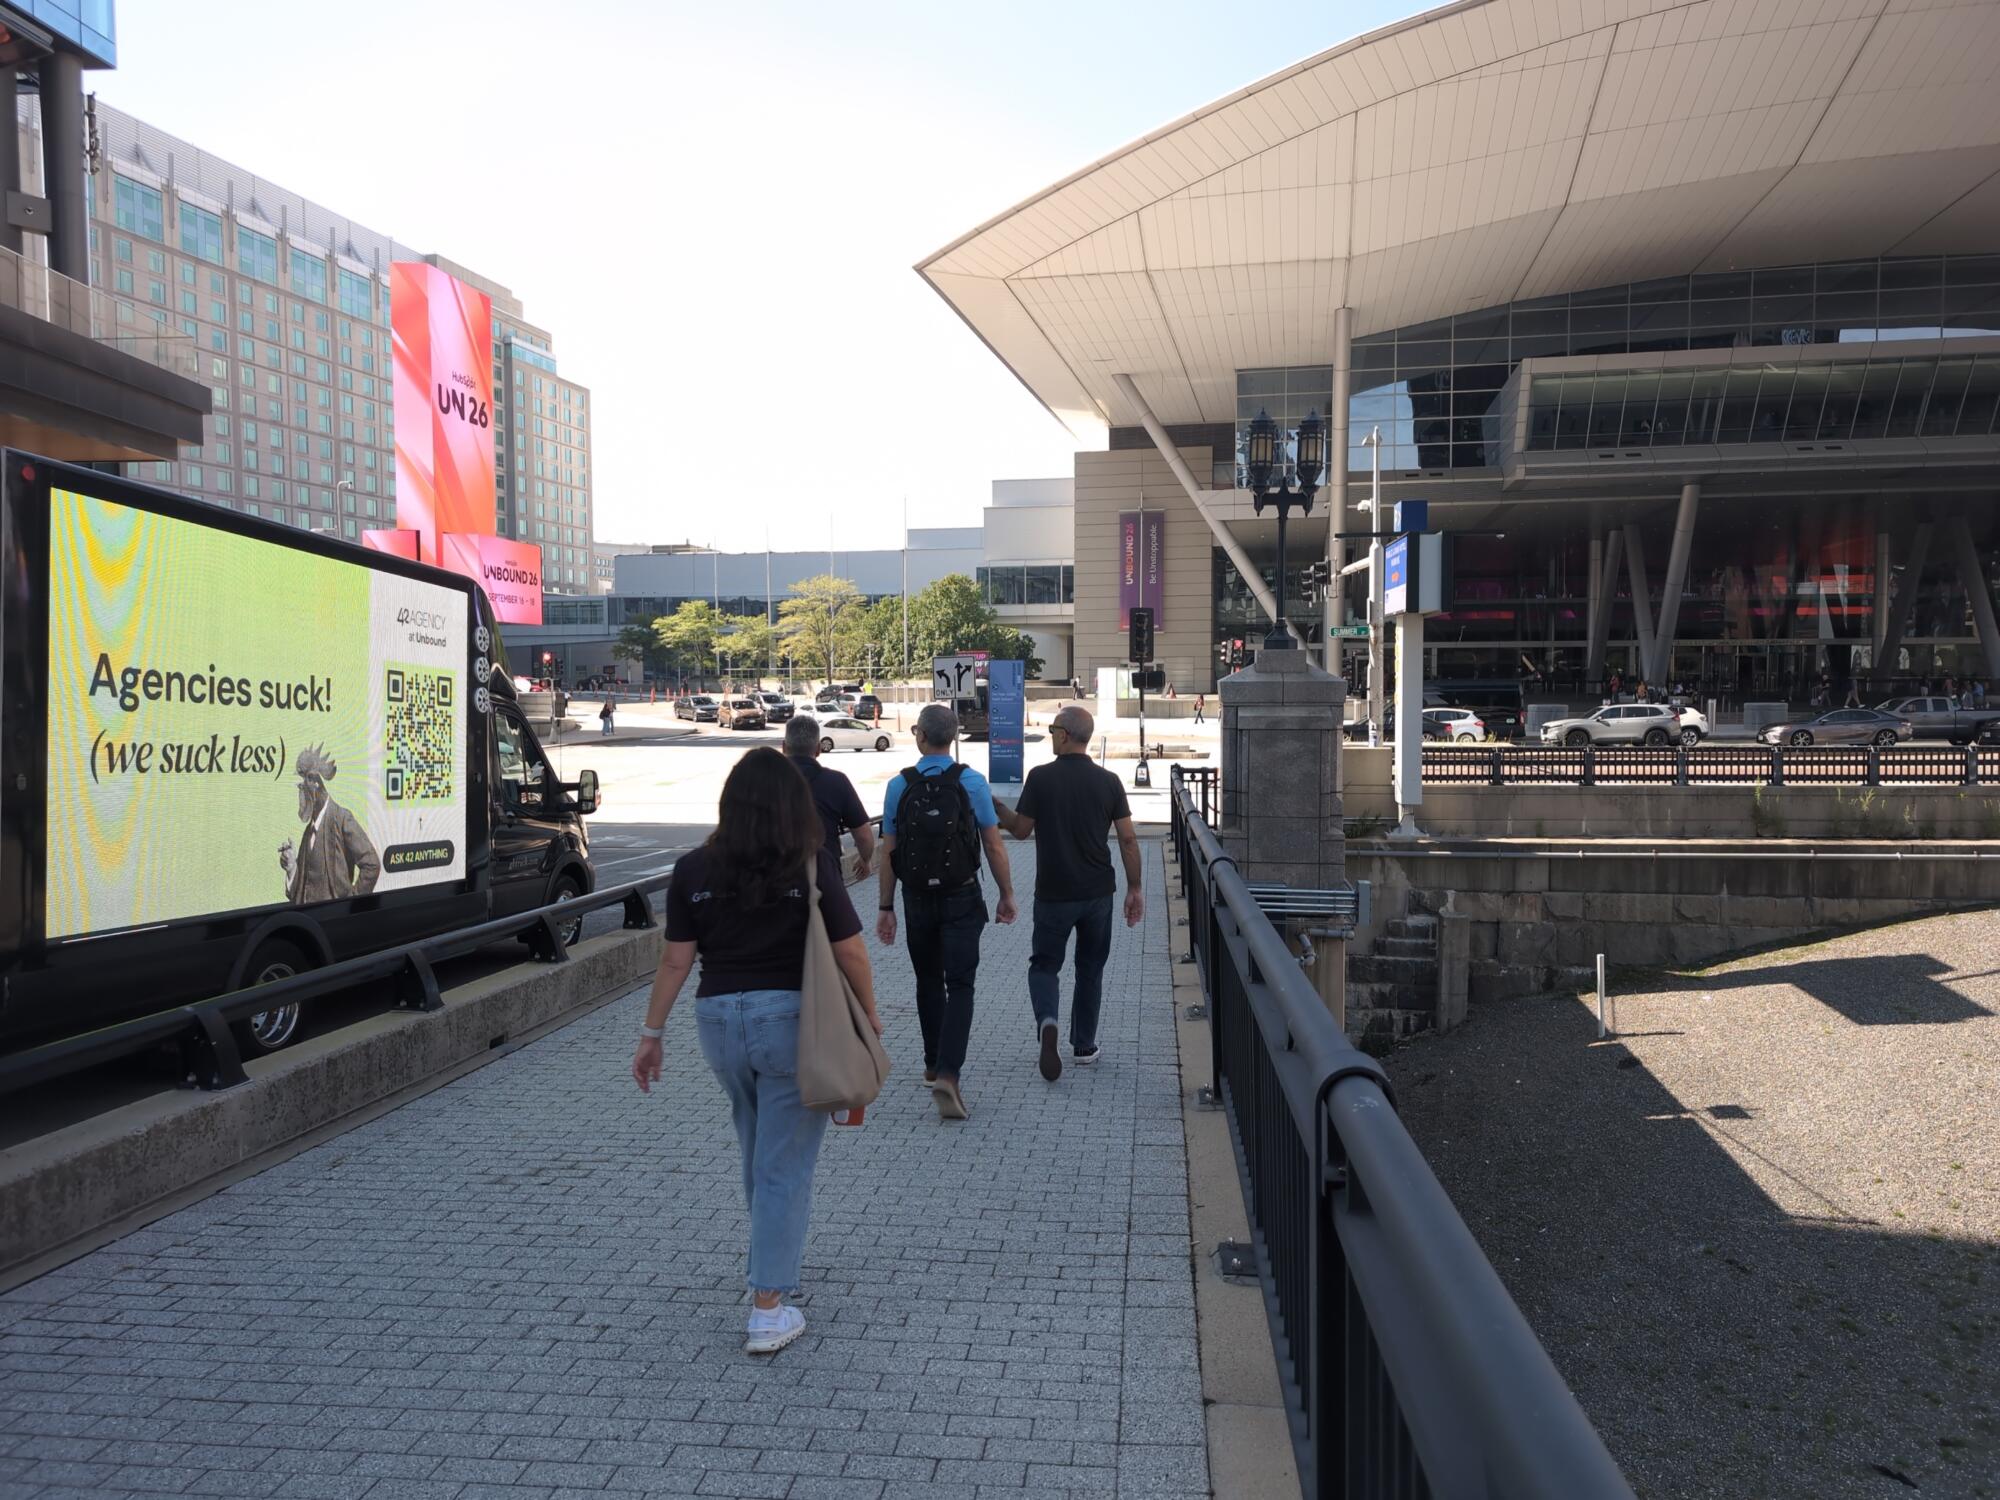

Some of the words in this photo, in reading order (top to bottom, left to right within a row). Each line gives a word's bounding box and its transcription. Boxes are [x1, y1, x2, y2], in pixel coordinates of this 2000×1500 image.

[437, 383, 465, 421] UN
[469, 396, 488, 428] 26
[1126, 536, 1134, 585] UNBOUND
[483, 564, 528, 585] UNBOUND
[528, 571, 538, 586] 26
[1149, 574, 1157, 585] Be
[408, 632, 415, 642] at
[416, 631, 447, 648] Unbound
[89, 652, 252, 713] Agencies
[259, 674, 332, 713] suck!
[935, 688, 954, 697] ONLY
[90, 728, 154, 785] (we
[159, 733, 226, 774] suck
[230, 734, 286, 782] less)
[390, 852, 404, 865] ASK
[405, 850, 414, 862] 42
[414, 847, 449, 862] ANYTHING
